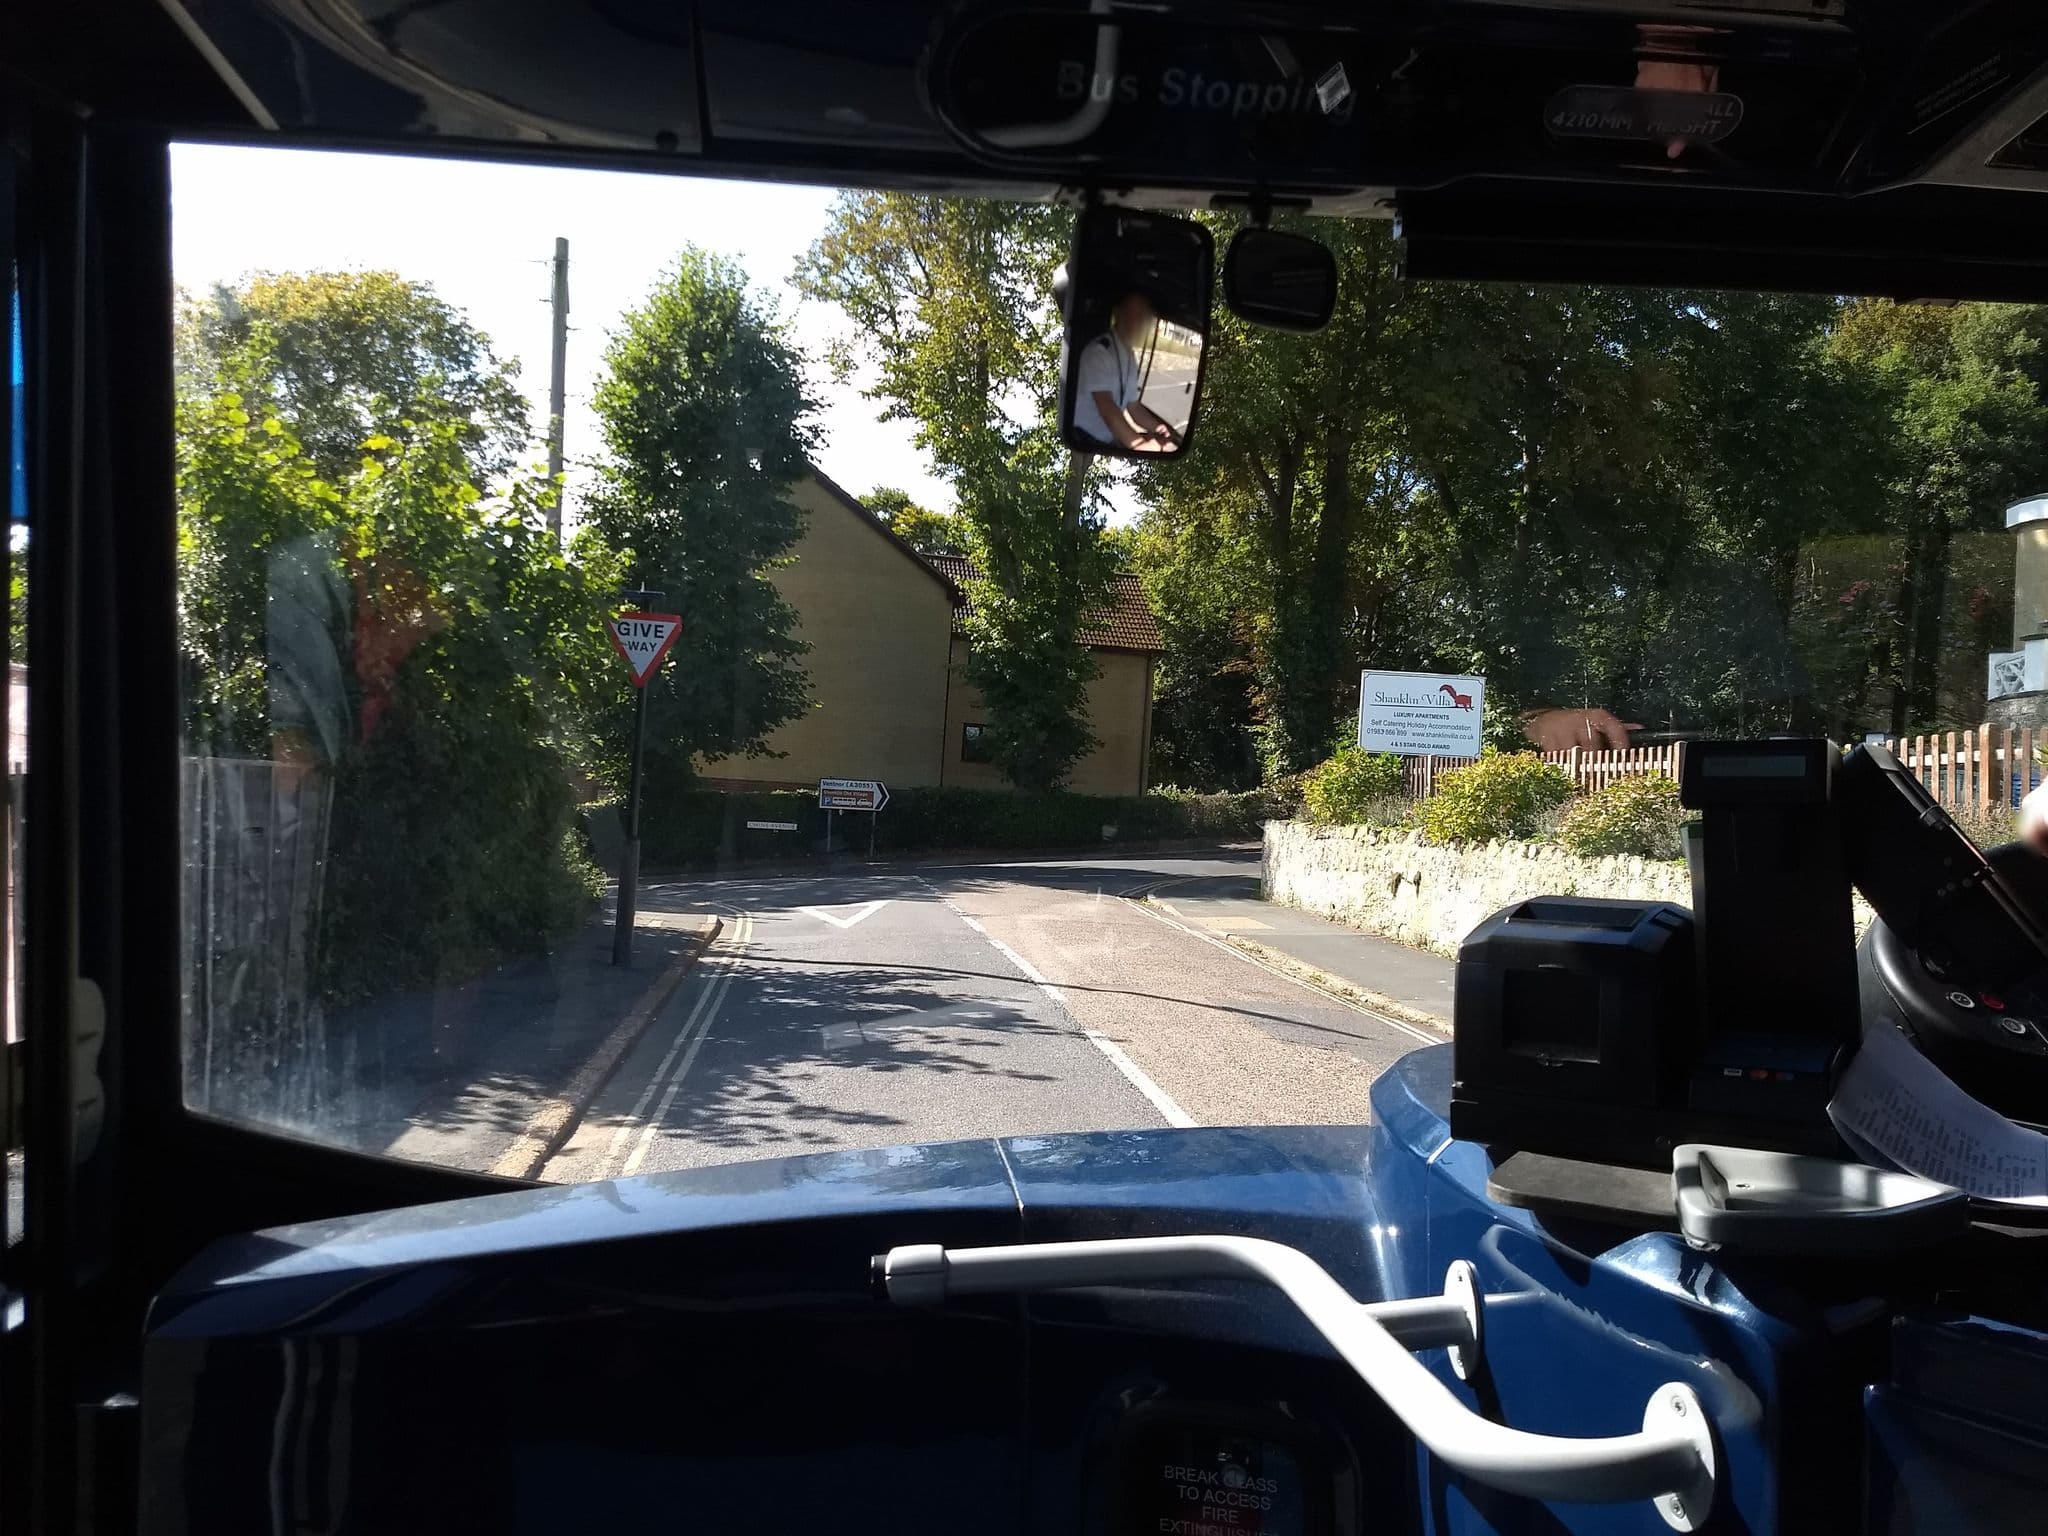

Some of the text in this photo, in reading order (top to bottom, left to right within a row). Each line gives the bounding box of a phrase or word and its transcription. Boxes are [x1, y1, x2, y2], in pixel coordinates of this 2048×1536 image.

[1056, 60, 1358, 126] Bus Stoppig
[617, 621, 665, 639] GIVE
[627, 640, 657, 652] WAY
[1374, 691, 1451, 706] Shanklin Villa
[1393, 711, 1450, 720] LUXURY APARTMENTS
[822, 780, 845, 788] Ventnor
[1164, 1465, 1279, 1493] BREAK GLASS
[1176, 1484, 1272, 1511] TO ACCESS
[1201, 1505, 1240, 1525] FIRE
